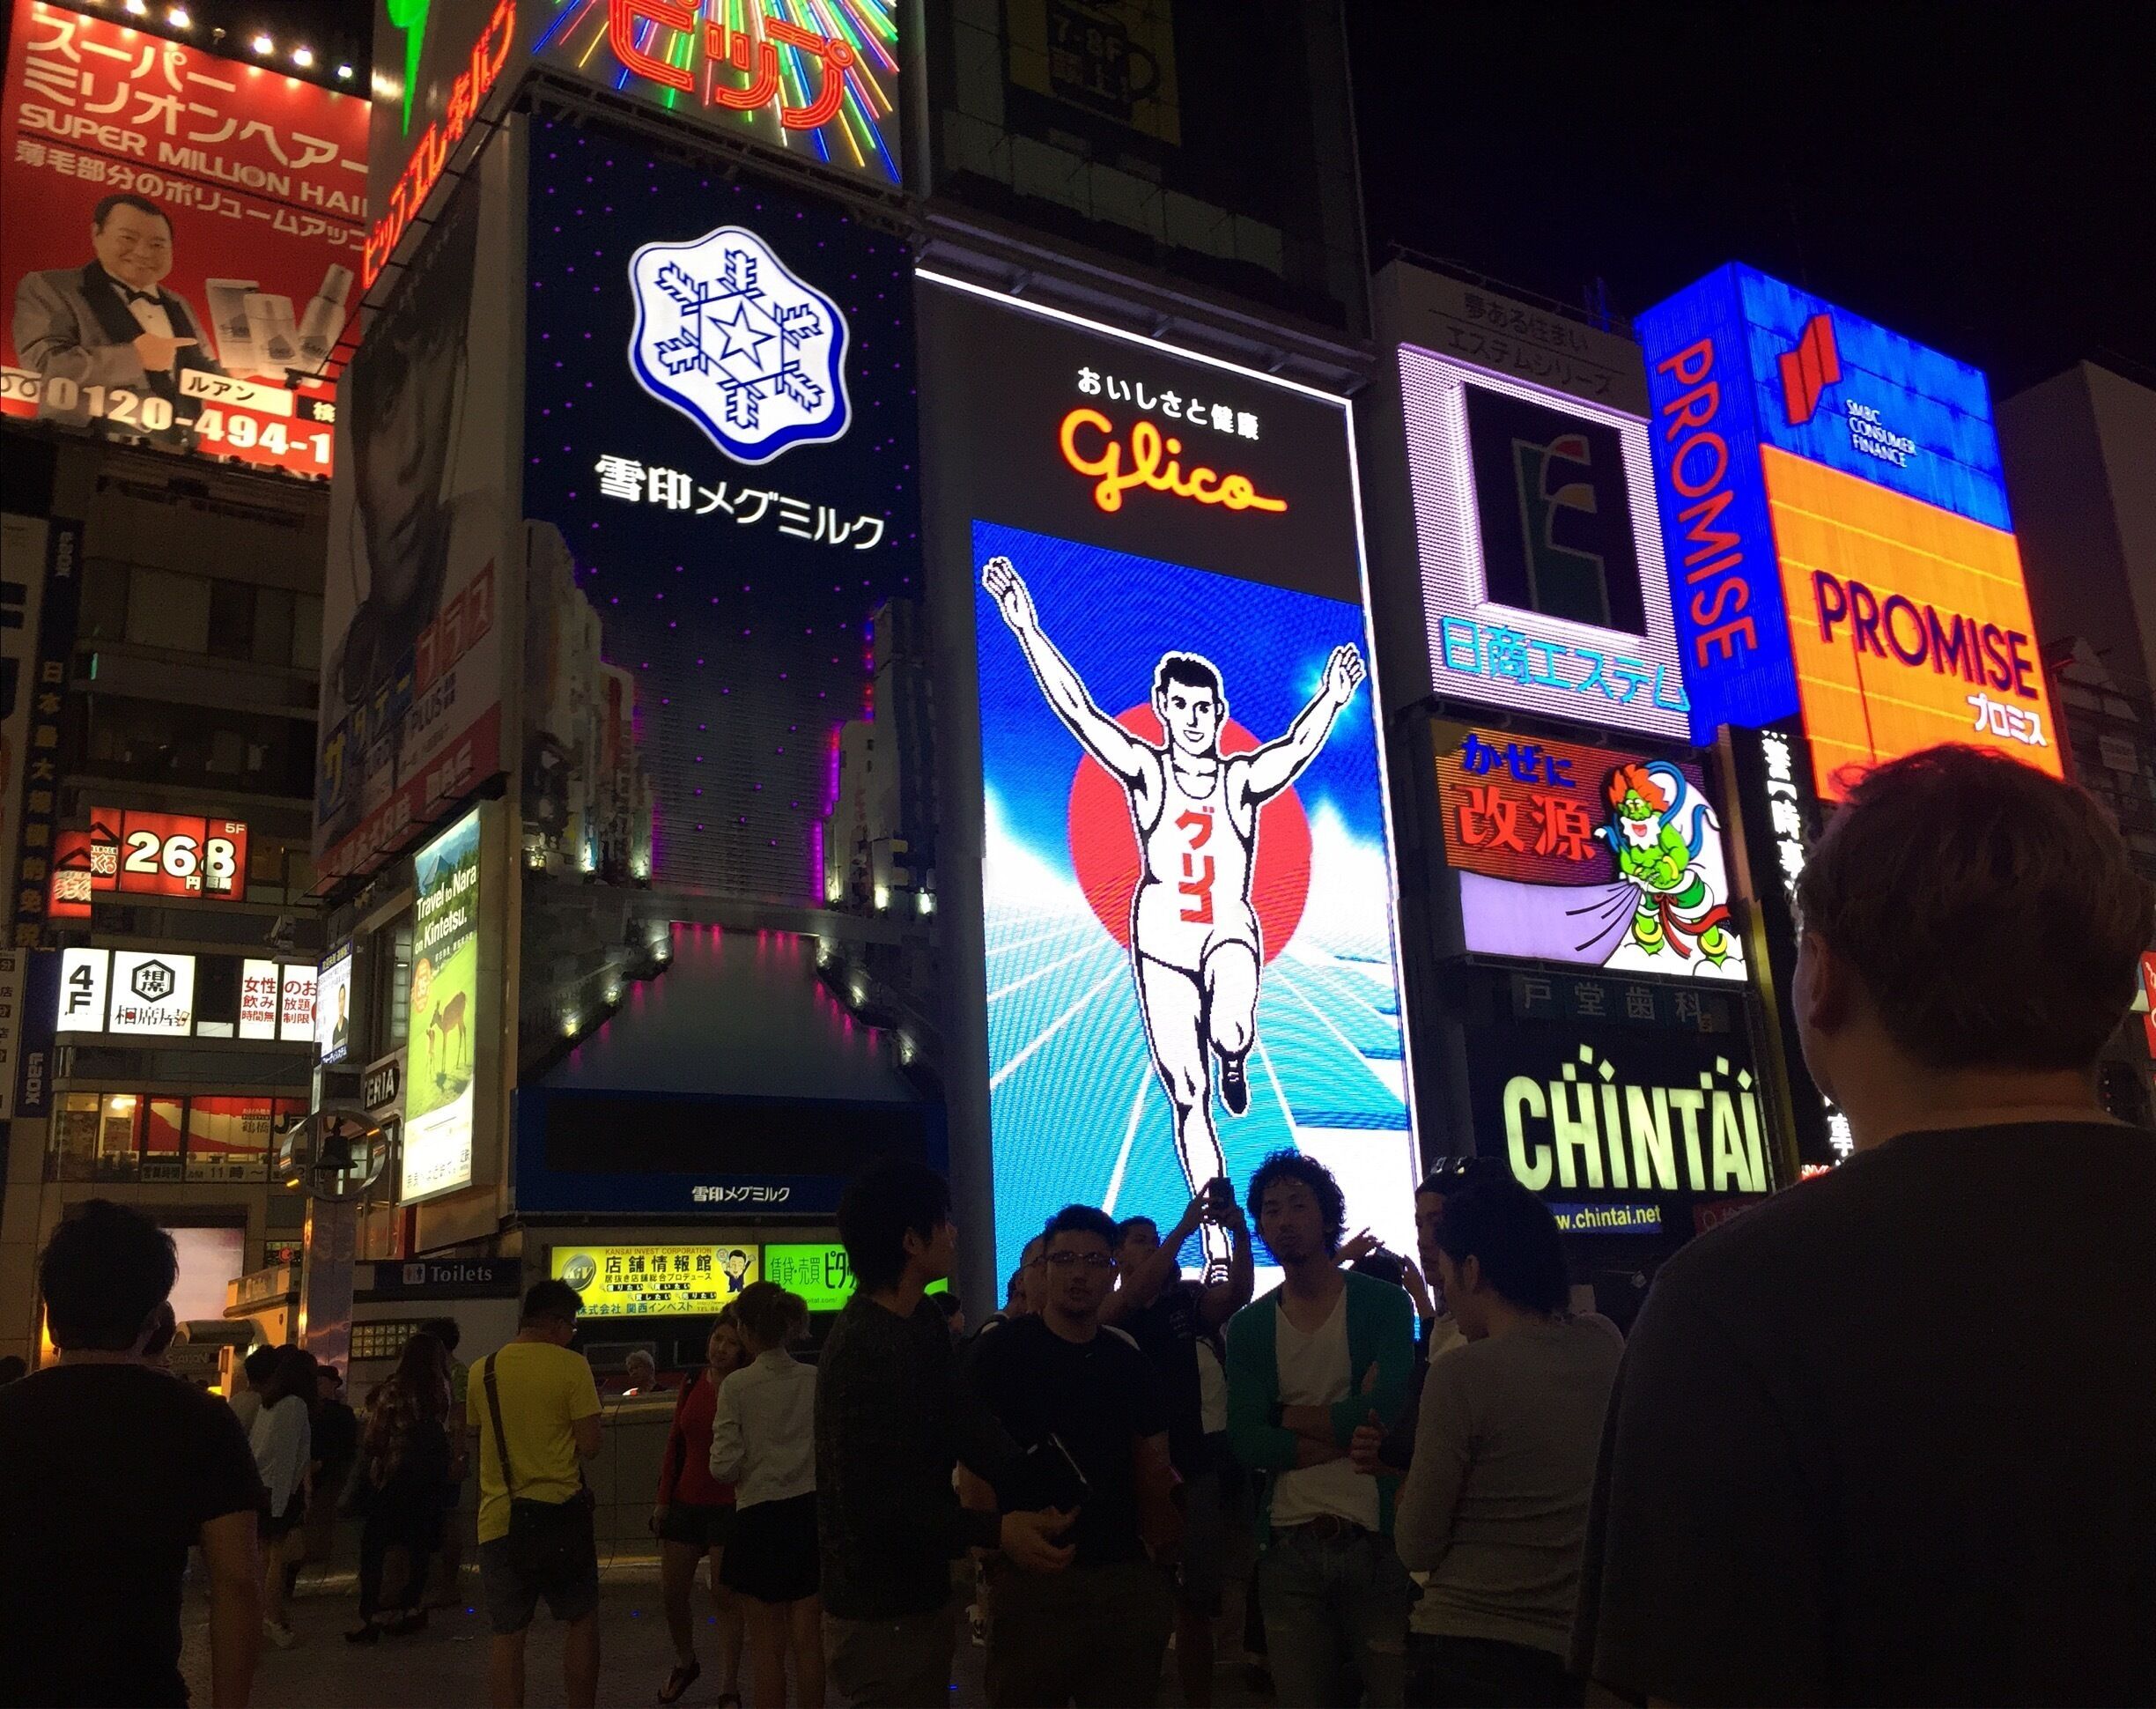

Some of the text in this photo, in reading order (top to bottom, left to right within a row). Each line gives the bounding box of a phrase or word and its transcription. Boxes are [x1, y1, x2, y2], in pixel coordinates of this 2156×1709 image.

[27, 12, 236, 92] スーパー
[24, 55, 368, 174] ミリオンヘアー
[18, 102, 147, 156] SUPER
[159, 142, 290, 196] MILLION
[1447, 325, 1611, 394] エステムシリーズ
[189, 375, 255, 401] ルアン
[1078, 366, 1259, 440] おいしさと健康
[1846, 399, 1882, 425] SMBC
[1060, 409, 1288, 512] Glico
[1850, 417, 1918, 455] CONSUMER
[1852, 433, 1908, 467] FINANCE
[595, 454, 884, 550] 雪印メグミルク
[1658, 338, 1758, 668] PROMISE
[1813, 569, 2039, 699] PROMISE
[1441, 616, 1690, 712] 日商エステム
[1967, 692, 2049, 747] プロミス
[1461, 733, 1576, 788] かぜに
[225, 822, 246, 834] 5F
[1453, 786, 1596, 862] 改源
[125, 831, 235, 878] 268
[1175, 805, 1215, 925] グリコ
[186, 876, 201, 890] 円
[417, 864, 476, 921] Travel to Nara
[415, 938, 424, 955] on
[425, 906, 468, 949] Kintetsu.
[1503, 1057, 1767, 1192] CHINTAI
[691, 1186, 790, 1202] 雪印メグミルク
[431, 1264, 493, 1283] Toilets
[604, 1272, 712, 1284] 居抜き店舗総合プロデュース
[605, 1254, 712, 1274] 店舗情報館
